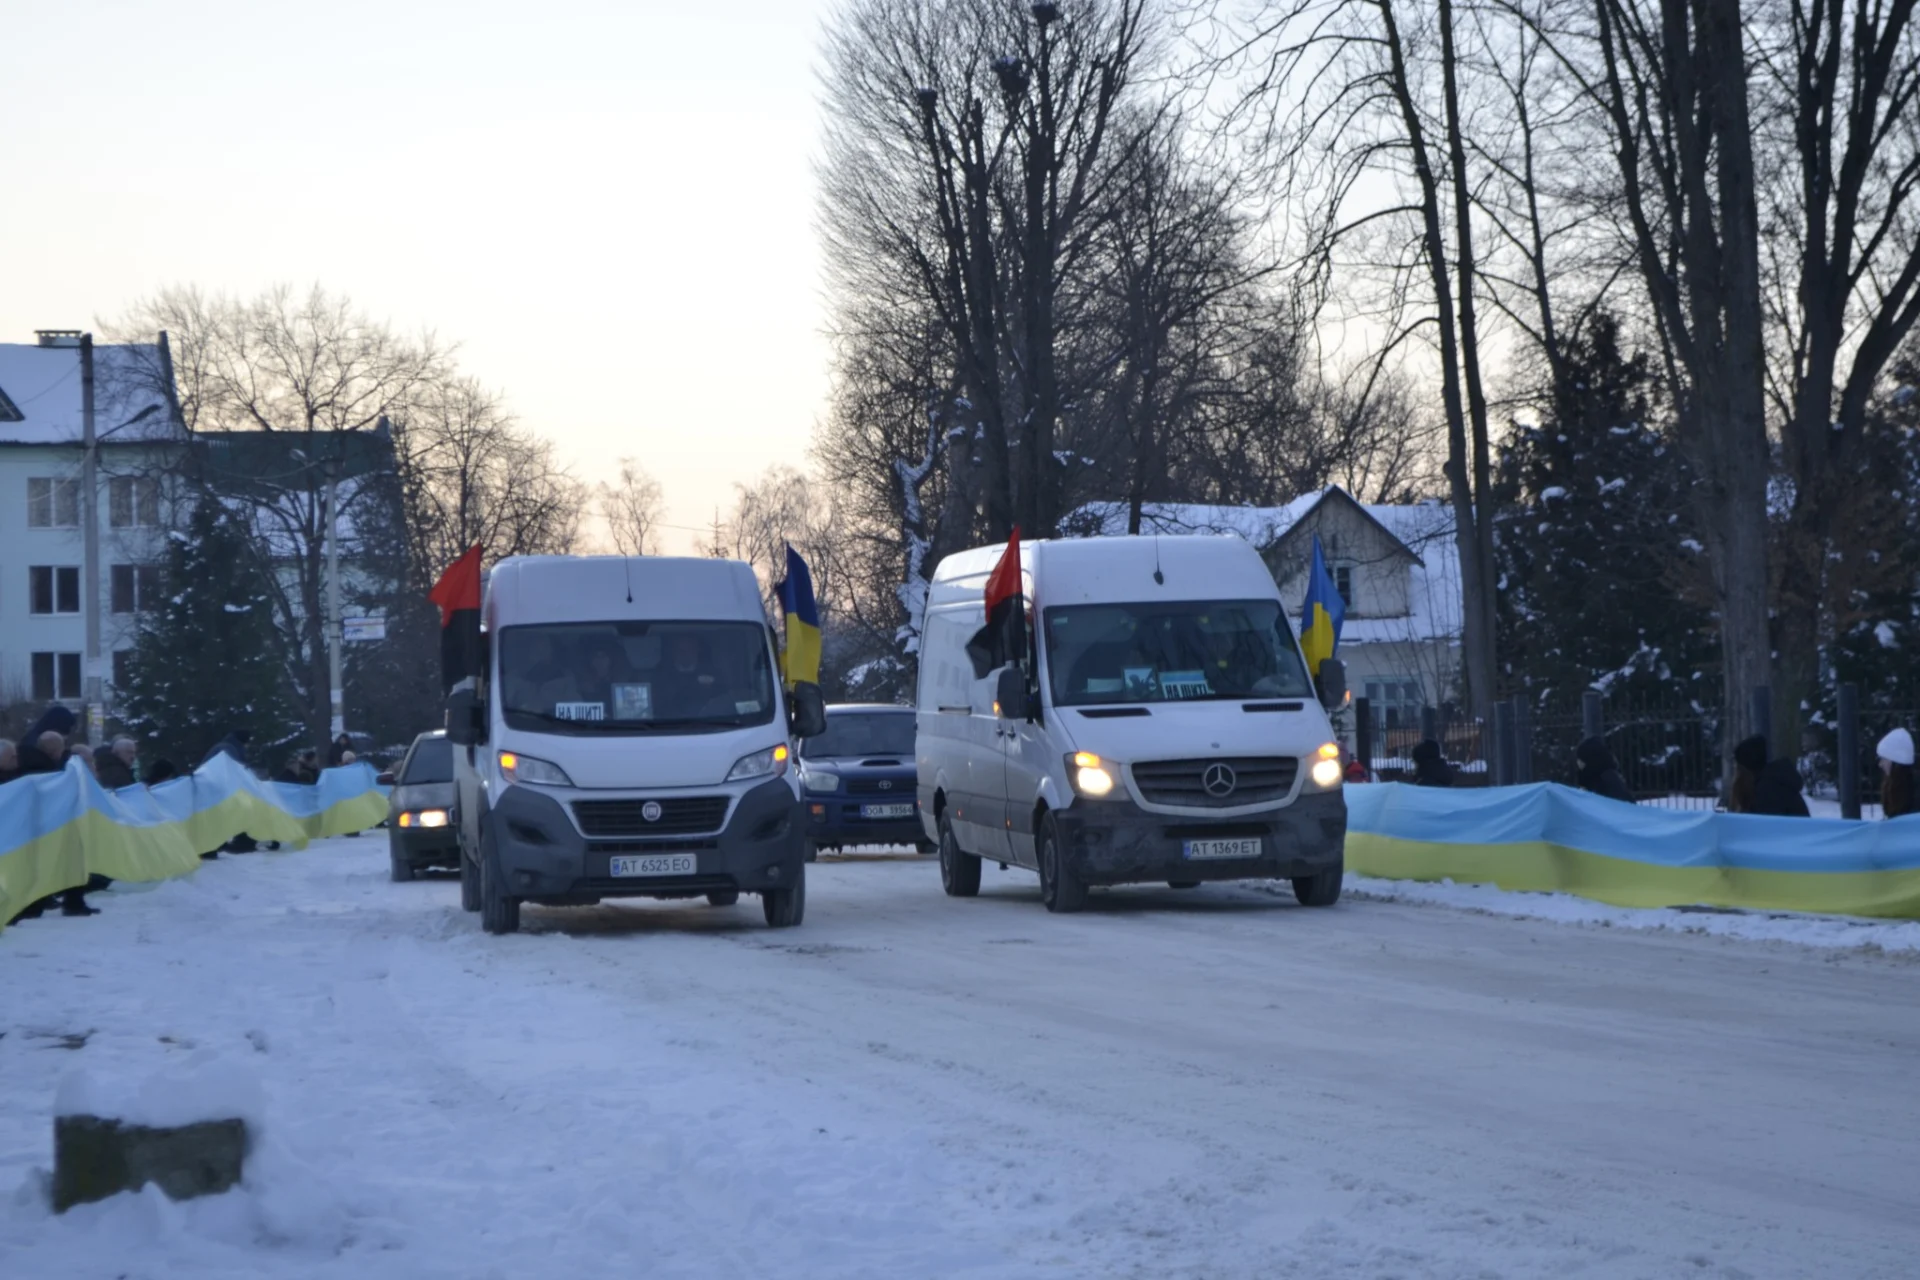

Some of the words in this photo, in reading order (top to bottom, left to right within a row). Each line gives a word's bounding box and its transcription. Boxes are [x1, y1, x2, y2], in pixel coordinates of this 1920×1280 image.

[1191, 842, 1208, 855] AT
[1212, 842, 1239, 855] 1369
[1241, 840, 1258, 853] ET
[620, 860, 637, 873] AT
[641, 859, 670, 872] 6525
[672, 858, 691, 871] EO
